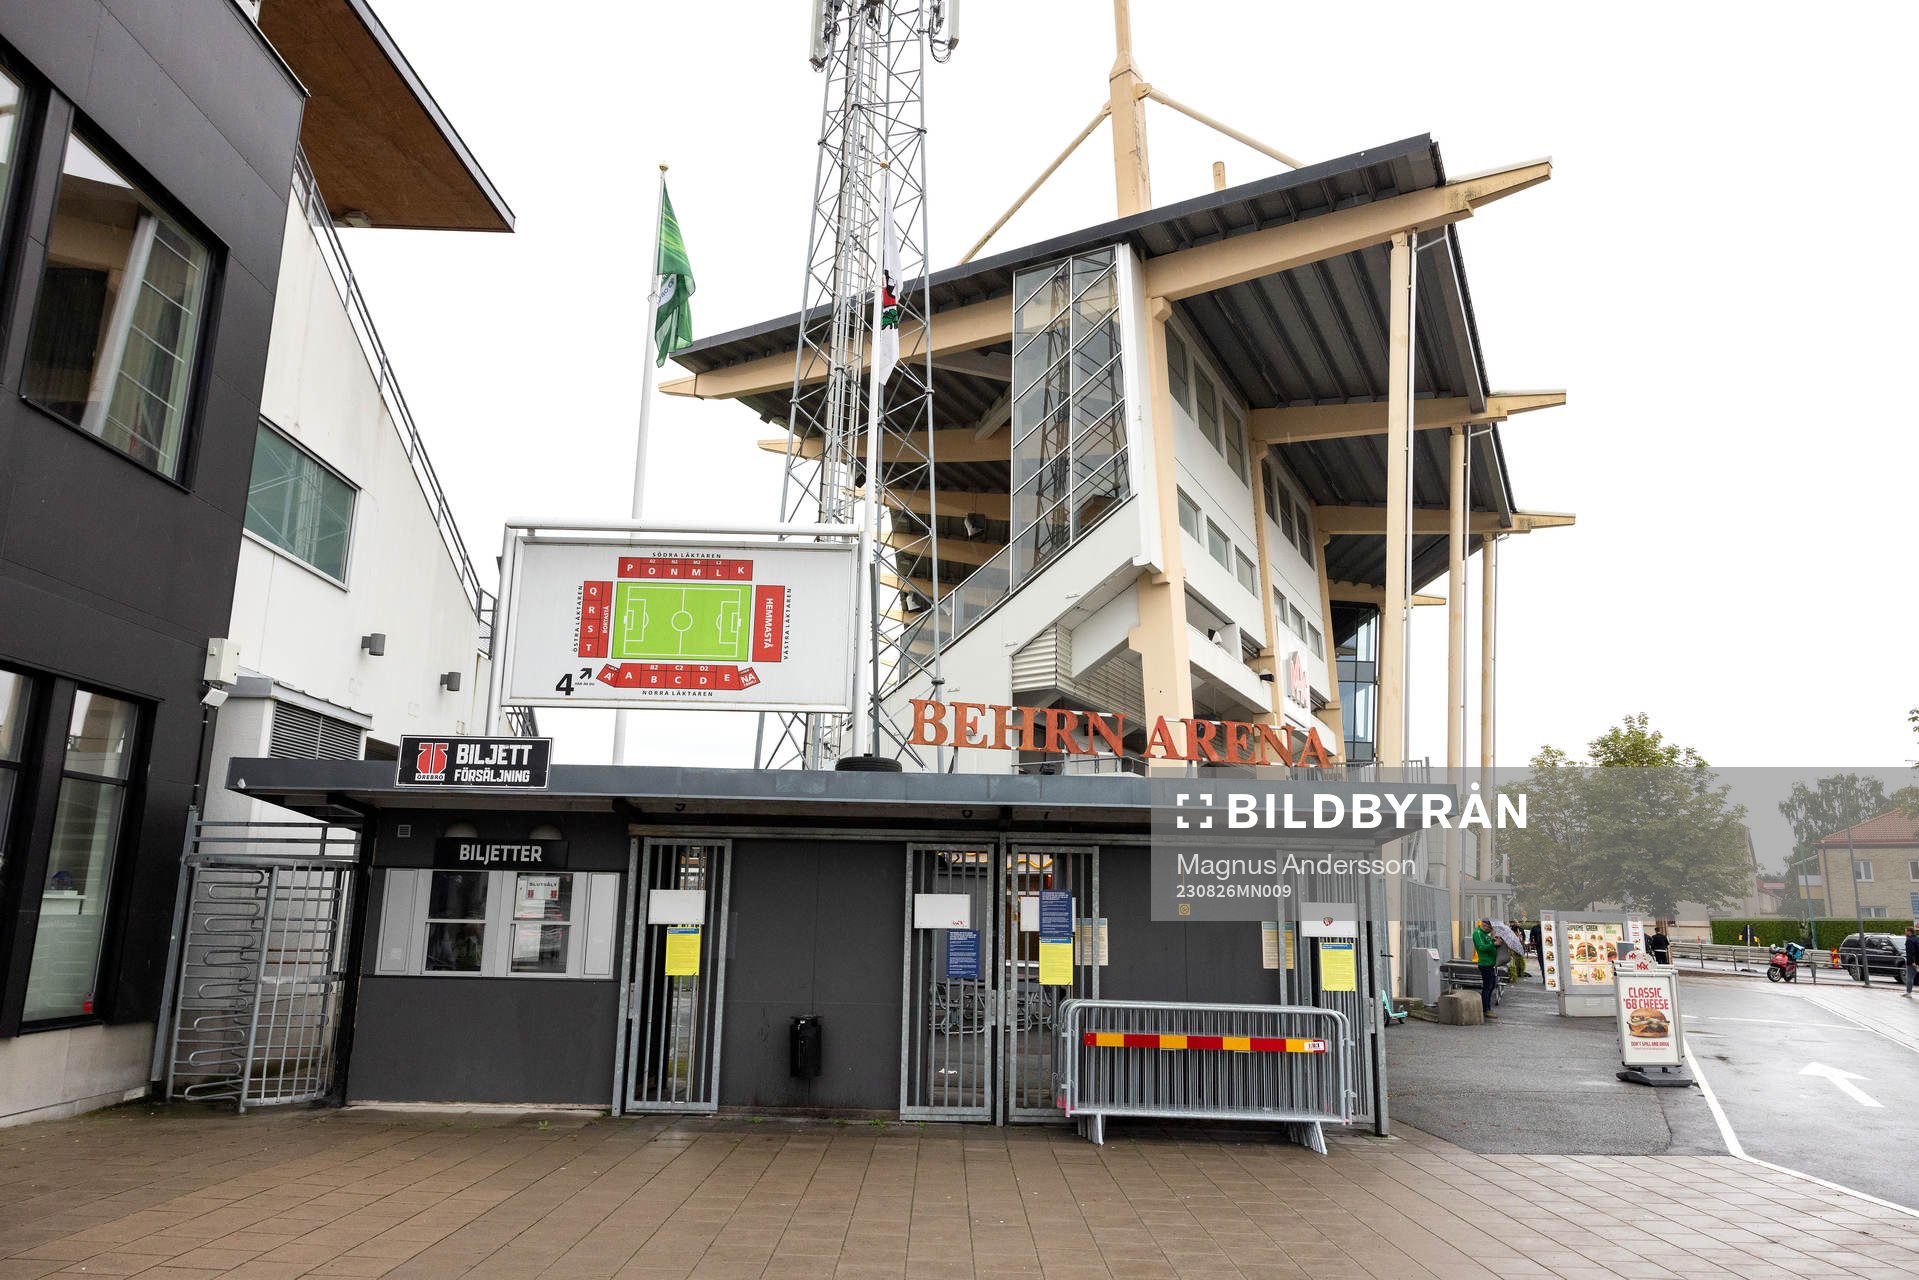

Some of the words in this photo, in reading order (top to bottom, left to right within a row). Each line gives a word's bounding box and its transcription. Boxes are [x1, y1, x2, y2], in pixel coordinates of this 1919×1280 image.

[626, 564, 634, 572] P
[738, 566, 744, 574] K
[590, 588, 597, 596] Q
[764, 598, 774, 648] HEMMASTÅ
[675, 676, 682, 684] C
[741, 673, 755, 684] NA
[556, 674, 574, 696] 4
[908, 698, 1126, 758] BEHRN
[1144, 714, 1331, 768] ARENA
[456, 744, 532, 765] BILJETT
[454, 767, 530, 782] FÖRSÄLJNING
[459, 844, 542, 865] BILJETTER
[1628, 987, 1662, 998] CLASSIC
[1624, 999, 1637, 1009] '68
[1639, 999, 1669, 1010] CHEESE
